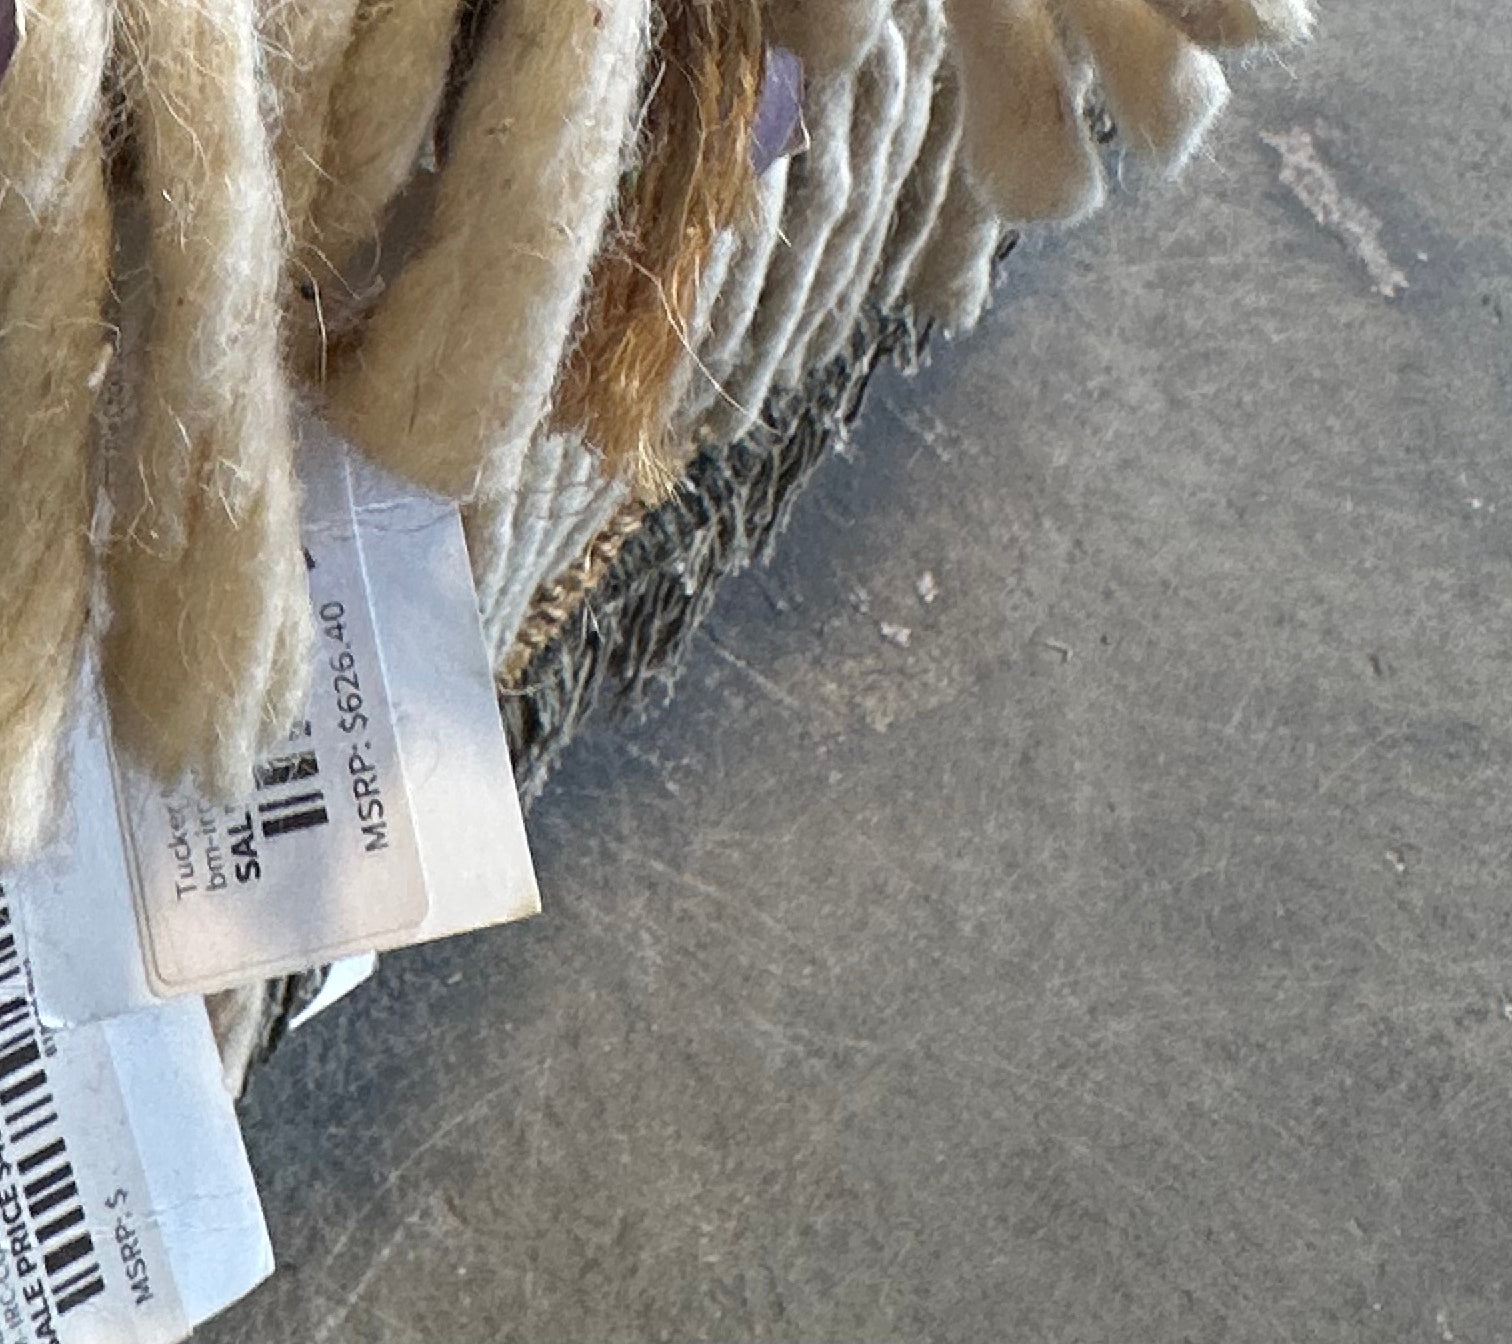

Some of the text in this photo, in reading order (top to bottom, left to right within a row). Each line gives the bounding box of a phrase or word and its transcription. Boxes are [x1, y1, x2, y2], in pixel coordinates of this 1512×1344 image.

[319, 600, 389, 853] MSRP: $626.40
[225, 804, 261, 884] SAL
[113, 1211, 154, 1306] MSRP:
